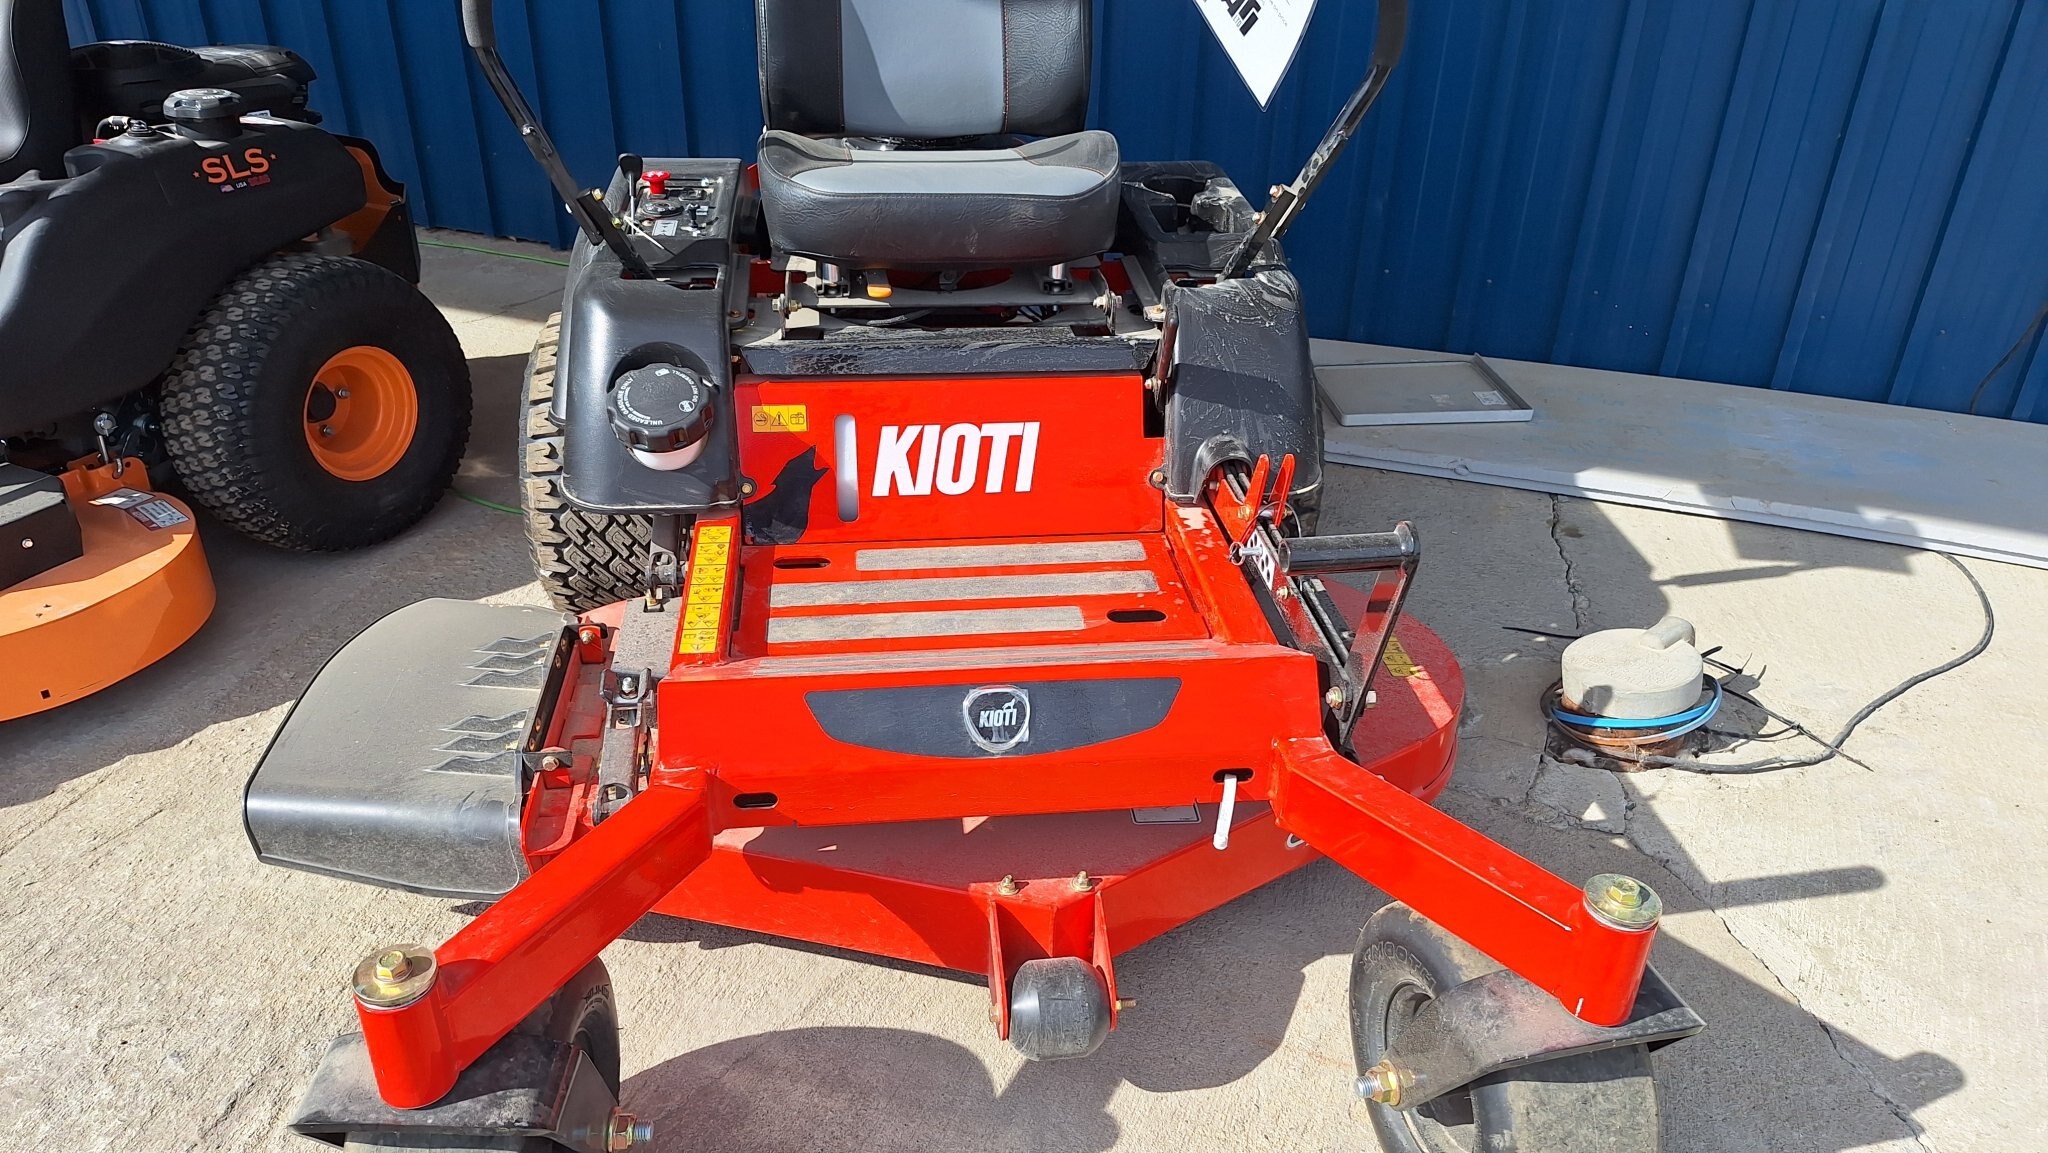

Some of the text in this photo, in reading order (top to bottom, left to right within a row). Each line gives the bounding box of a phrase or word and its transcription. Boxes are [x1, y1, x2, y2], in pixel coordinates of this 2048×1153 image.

[202, 148, 269, 183] SLS
[620, 376, 634, 390] ONLY
[672, 370, 695, 385] OVERFILL
[617, 391, 629, 415] GASOLINE
[692, 395, 699, 403] DO
[628, 413, 663, 425] UNLEADED
[872, 421, 1041, 497] KIOTI
[978, 708, 1018, 728] KIOTI
